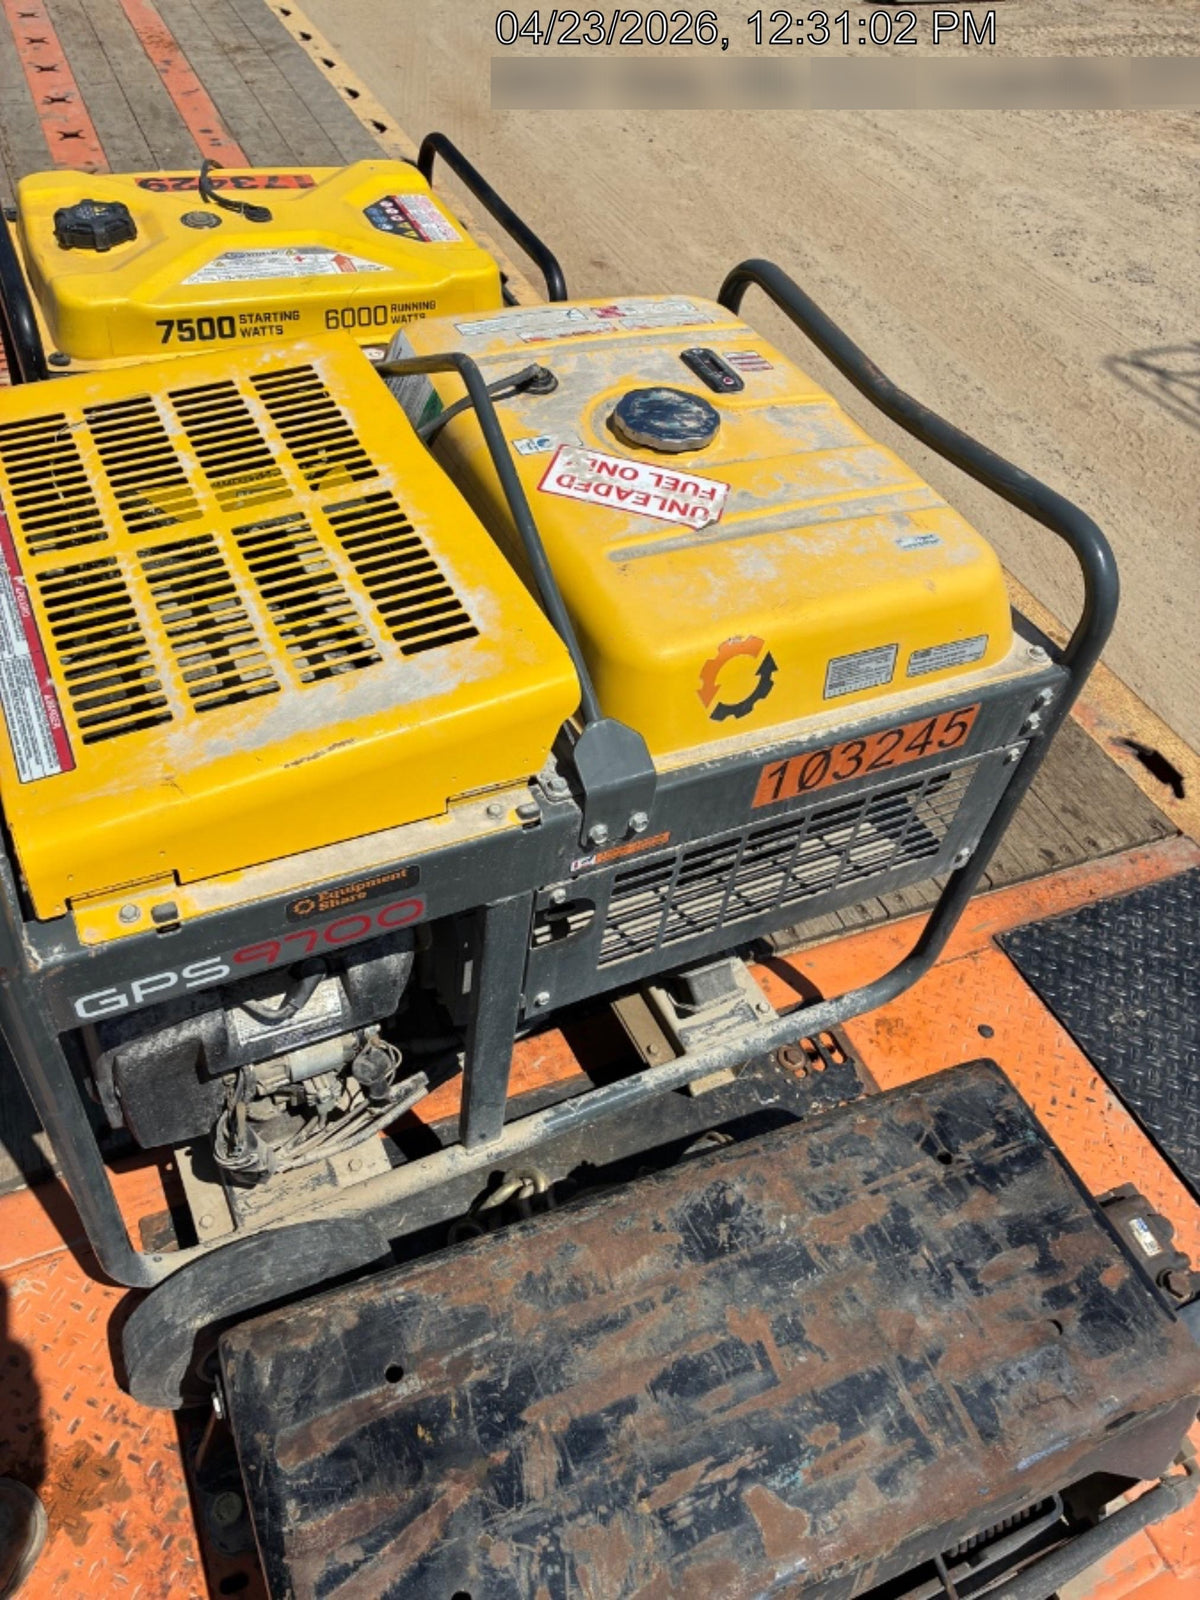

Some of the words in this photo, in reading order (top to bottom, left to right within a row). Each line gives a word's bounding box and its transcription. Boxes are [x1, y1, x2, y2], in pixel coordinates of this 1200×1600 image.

[156, 315, 236, 344] 7500
[239, 310, 300, 325] STARTING
[325, 305, 388, 330] 6000
[391, 300, 436, 313] RUNNING
[240, 325, 284, 338] WATTS
[565, 458, 640, 481] ONL
[648, 472, 717, 500] FUEL
[768, 706, 976, 801] 103245
[318, 868, 407, 902] Equipment
